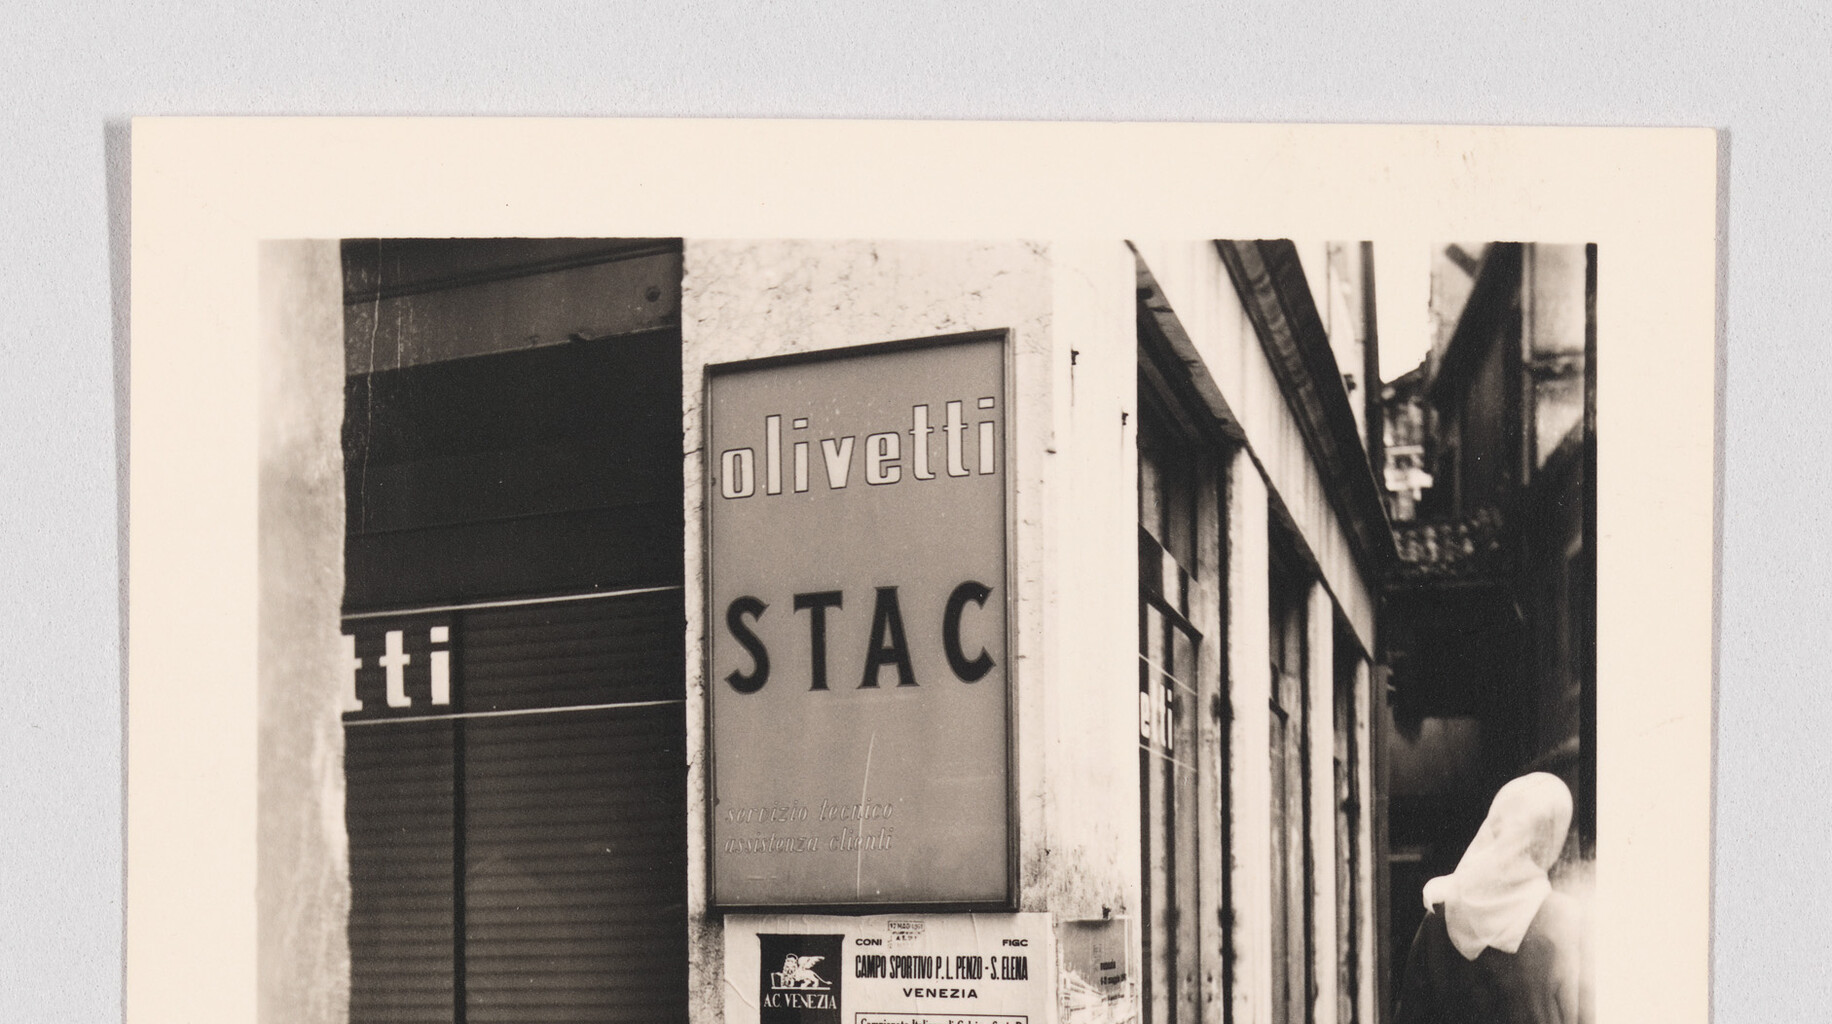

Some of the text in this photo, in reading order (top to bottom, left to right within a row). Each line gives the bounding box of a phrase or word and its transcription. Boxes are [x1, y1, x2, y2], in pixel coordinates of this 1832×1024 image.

[720, 396, 996, 500] olivetti
[723, 580, 997, 695] STAC
[725, 797, 894, 824] servizio tecnico
[723, 826, 895, 854] assistenza clienti
[855, 938, 882, 947] CONI
[1002, 938, 1029, 947] FIGC
[855, 954, 887, 979] CAMPO
[889, 955, 933, 980] SPORTIVO
[955, 956, 983, 980] PENZO
[990, 956, 1000, 980] S.
[1001, 956, 1029, 981] ELENA
[784, 993, 838, 1010] VENEZIA
[902, 987, 979, 999] VENEZIA
